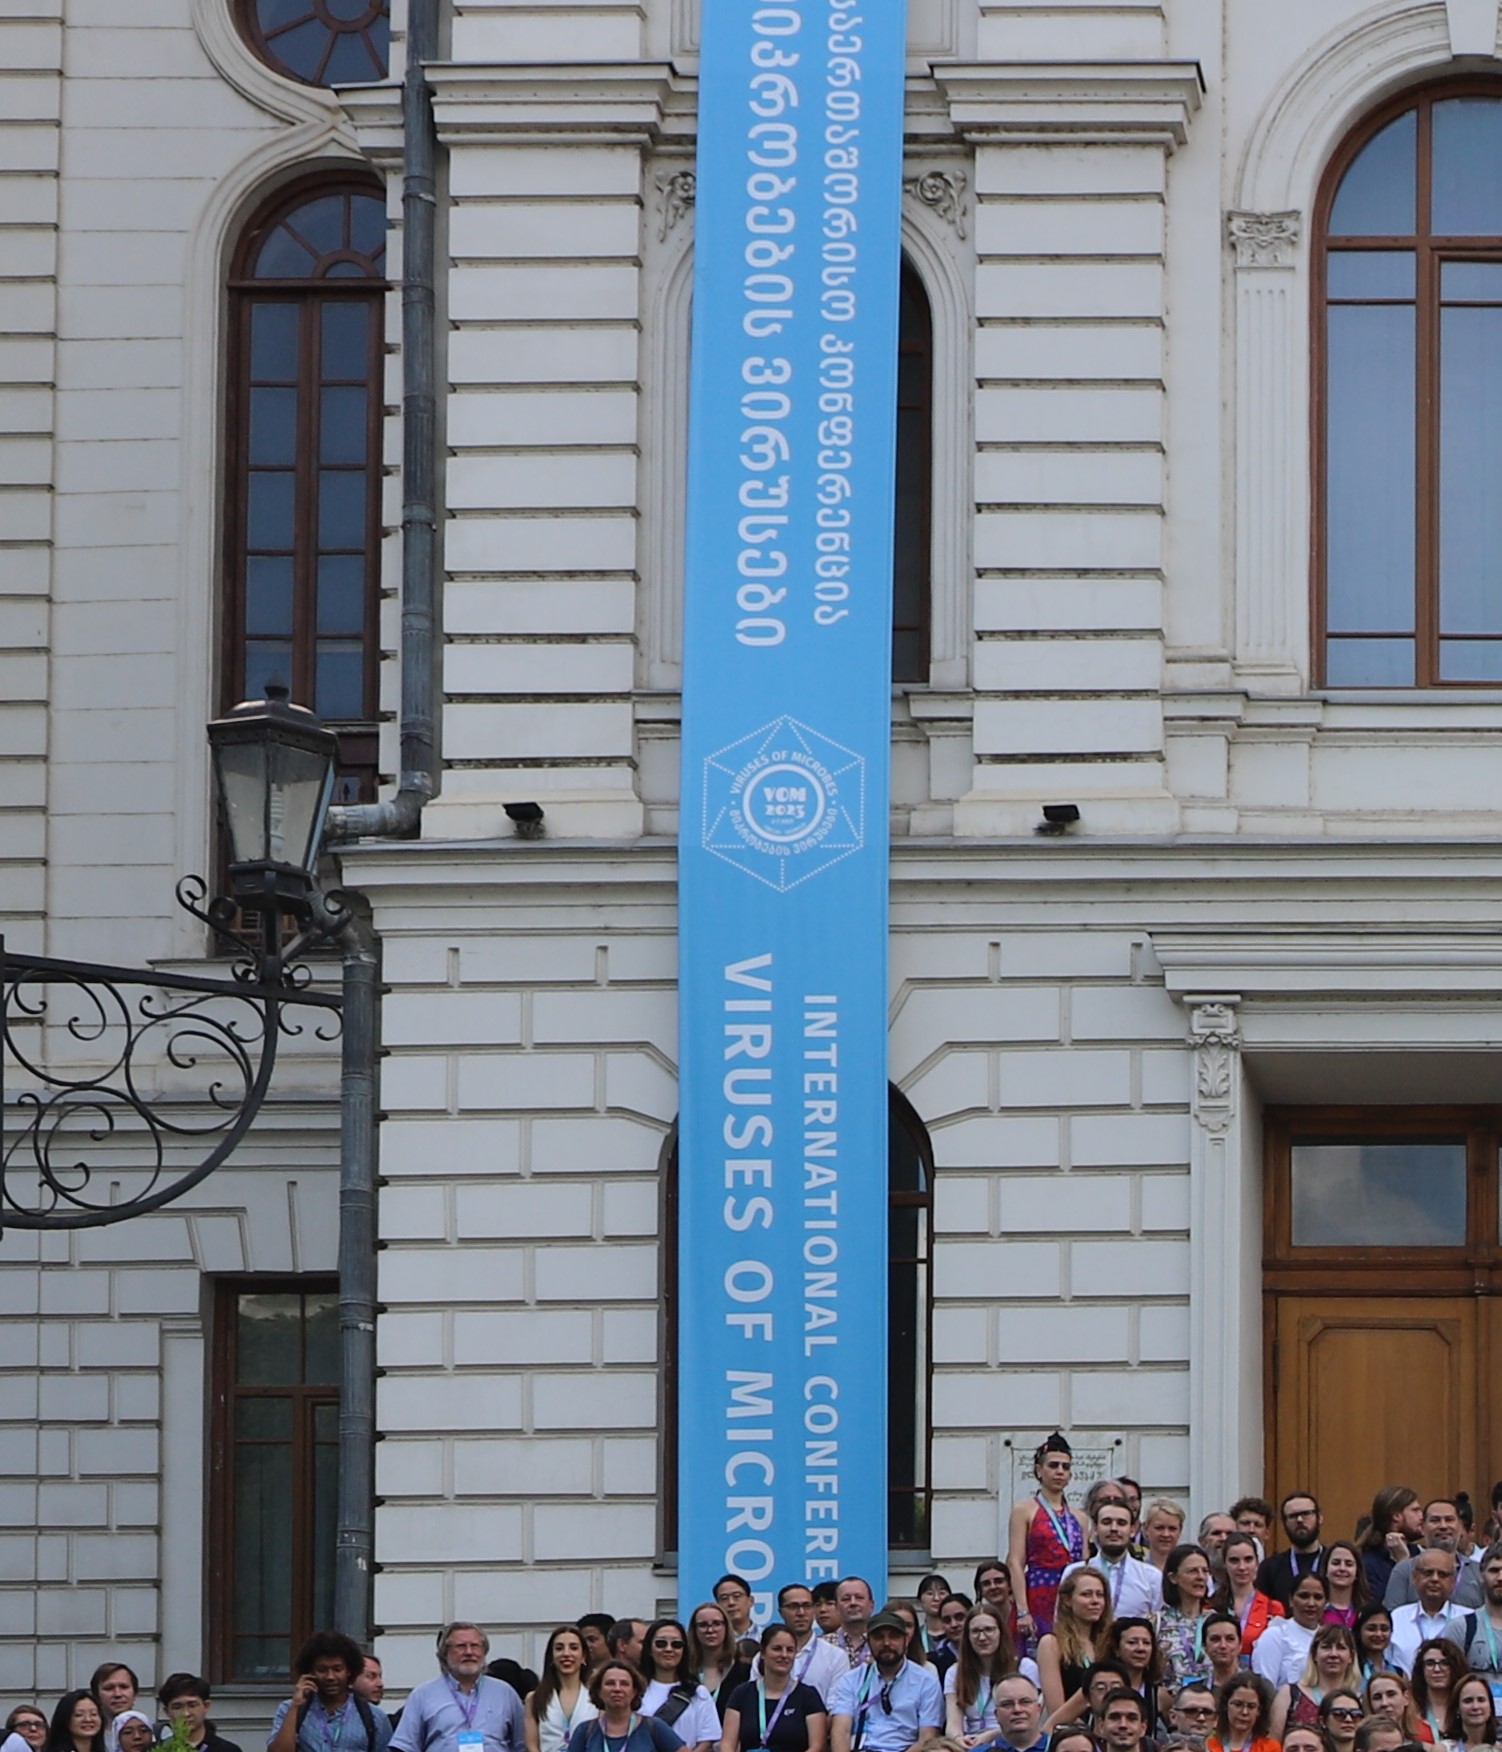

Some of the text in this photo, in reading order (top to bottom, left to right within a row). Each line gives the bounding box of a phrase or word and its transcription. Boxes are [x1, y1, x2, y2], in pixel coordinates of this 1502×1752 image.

[735, 0, 802, 648] იკრობების ვირუსები
[814, 333, 855, 626] კონფერენცია
[731, 750, 838, 796] VIRUSES OF MICROBES
[765, 804, 806, 819] 2023
[723, 953, 773, 1231] VIRUSES
[724, 1260, 774, 1341] OF
[804, 995, 839, 1580] INTERNATIONAL CONFERE
